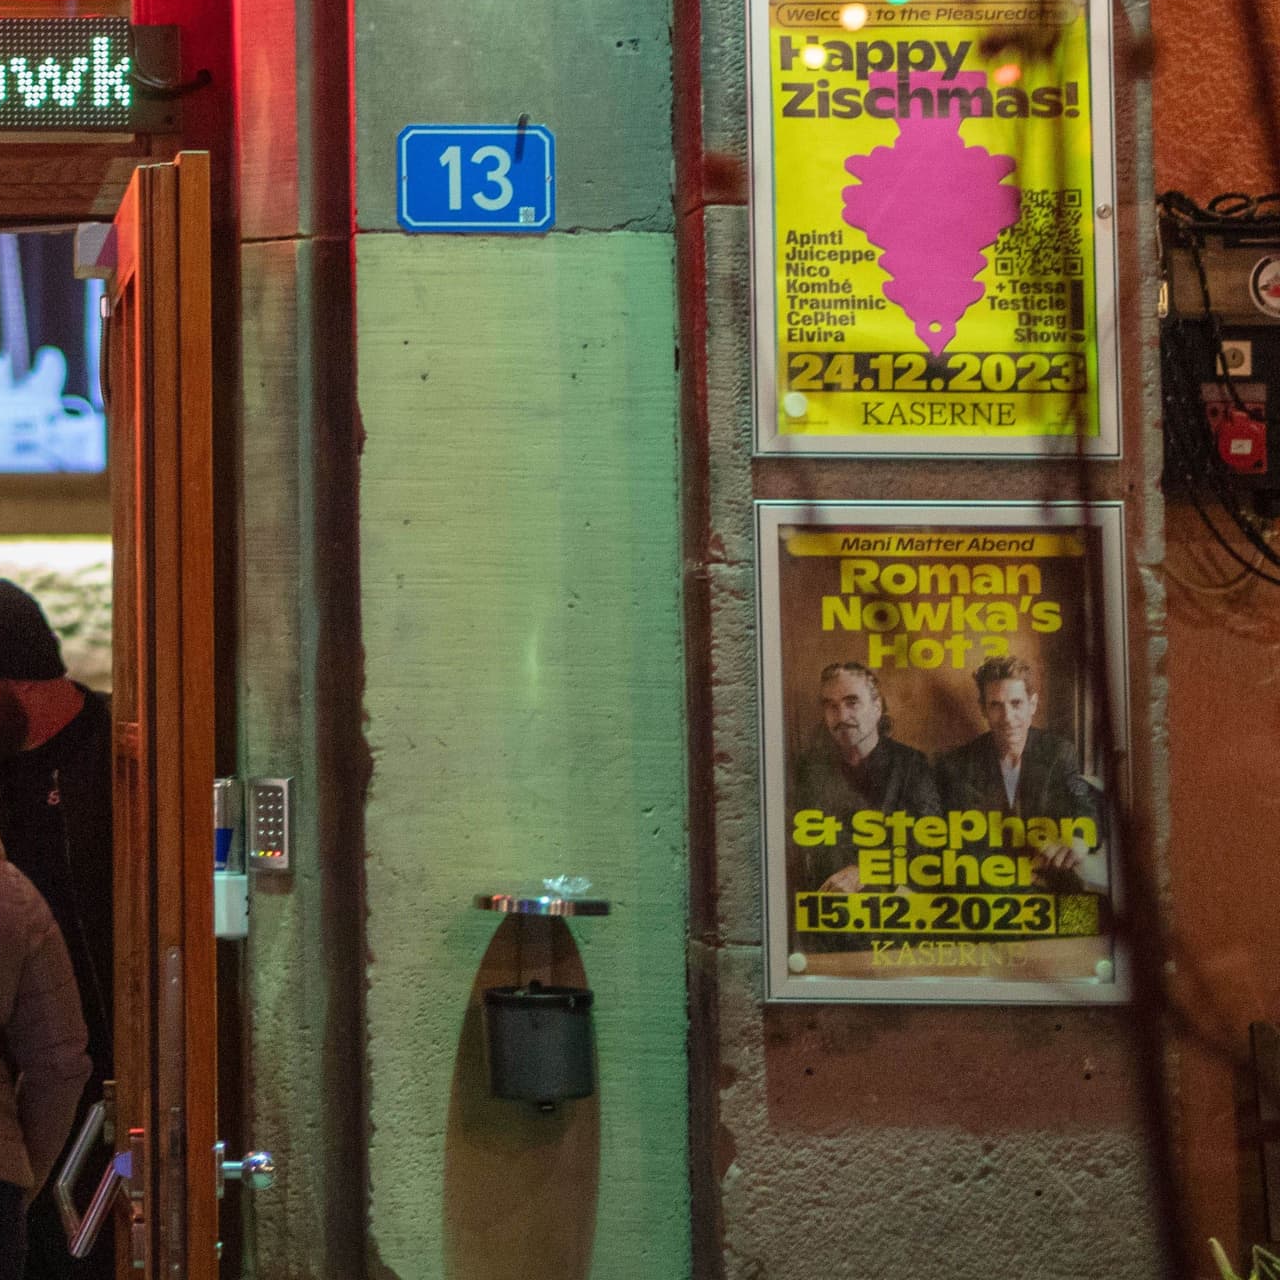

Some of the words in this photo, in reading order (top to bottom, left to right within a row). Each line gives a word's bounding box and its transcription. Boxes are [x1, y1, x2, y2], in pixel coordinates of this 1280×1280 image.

[876, 7, 894, 21] to
[900, 7, 930, 21] the
[780, 36, 972, 81] Happy
[782, 79, 1080, 119] Zischmas!
[439, 146, 513, 210] 13
[786, 230, 843, 247] Apinti
[786, 247, 875, 264] Juiceppe
[786, 263, 830, 277] Nico
[787, 279, 852, 294] Kombé
[1009, 280, 1065, 294] Tessa
[787, 296, 886, 310] Trauminic
[988, 297, 1066, 310] Testicle
[1019, 312, 1066, 329] Drag
[787, 329, 845, 343] Elvira
[1014, 329, 1066, 343] Show
[790, 354, 1084, 391] 24.12.2023
[862, 402, 1015, 426] KASERNE
[841, 537, 892, 552] Mani
[896, 537, 963, 552] Matter
[967, 537, 1034, 552] Abend
[841, 559, 1041, 594] Roman
[822, 596, 1062, 632] Nowka's
[869, 634, 973, 669] Hot
[792, 810, 843, 847] &
[852, 810, 1097, 849] Stephan
[858, 847, 1033, 886] Eicher
[799, 896, 1051, 930] 15.12.2023
